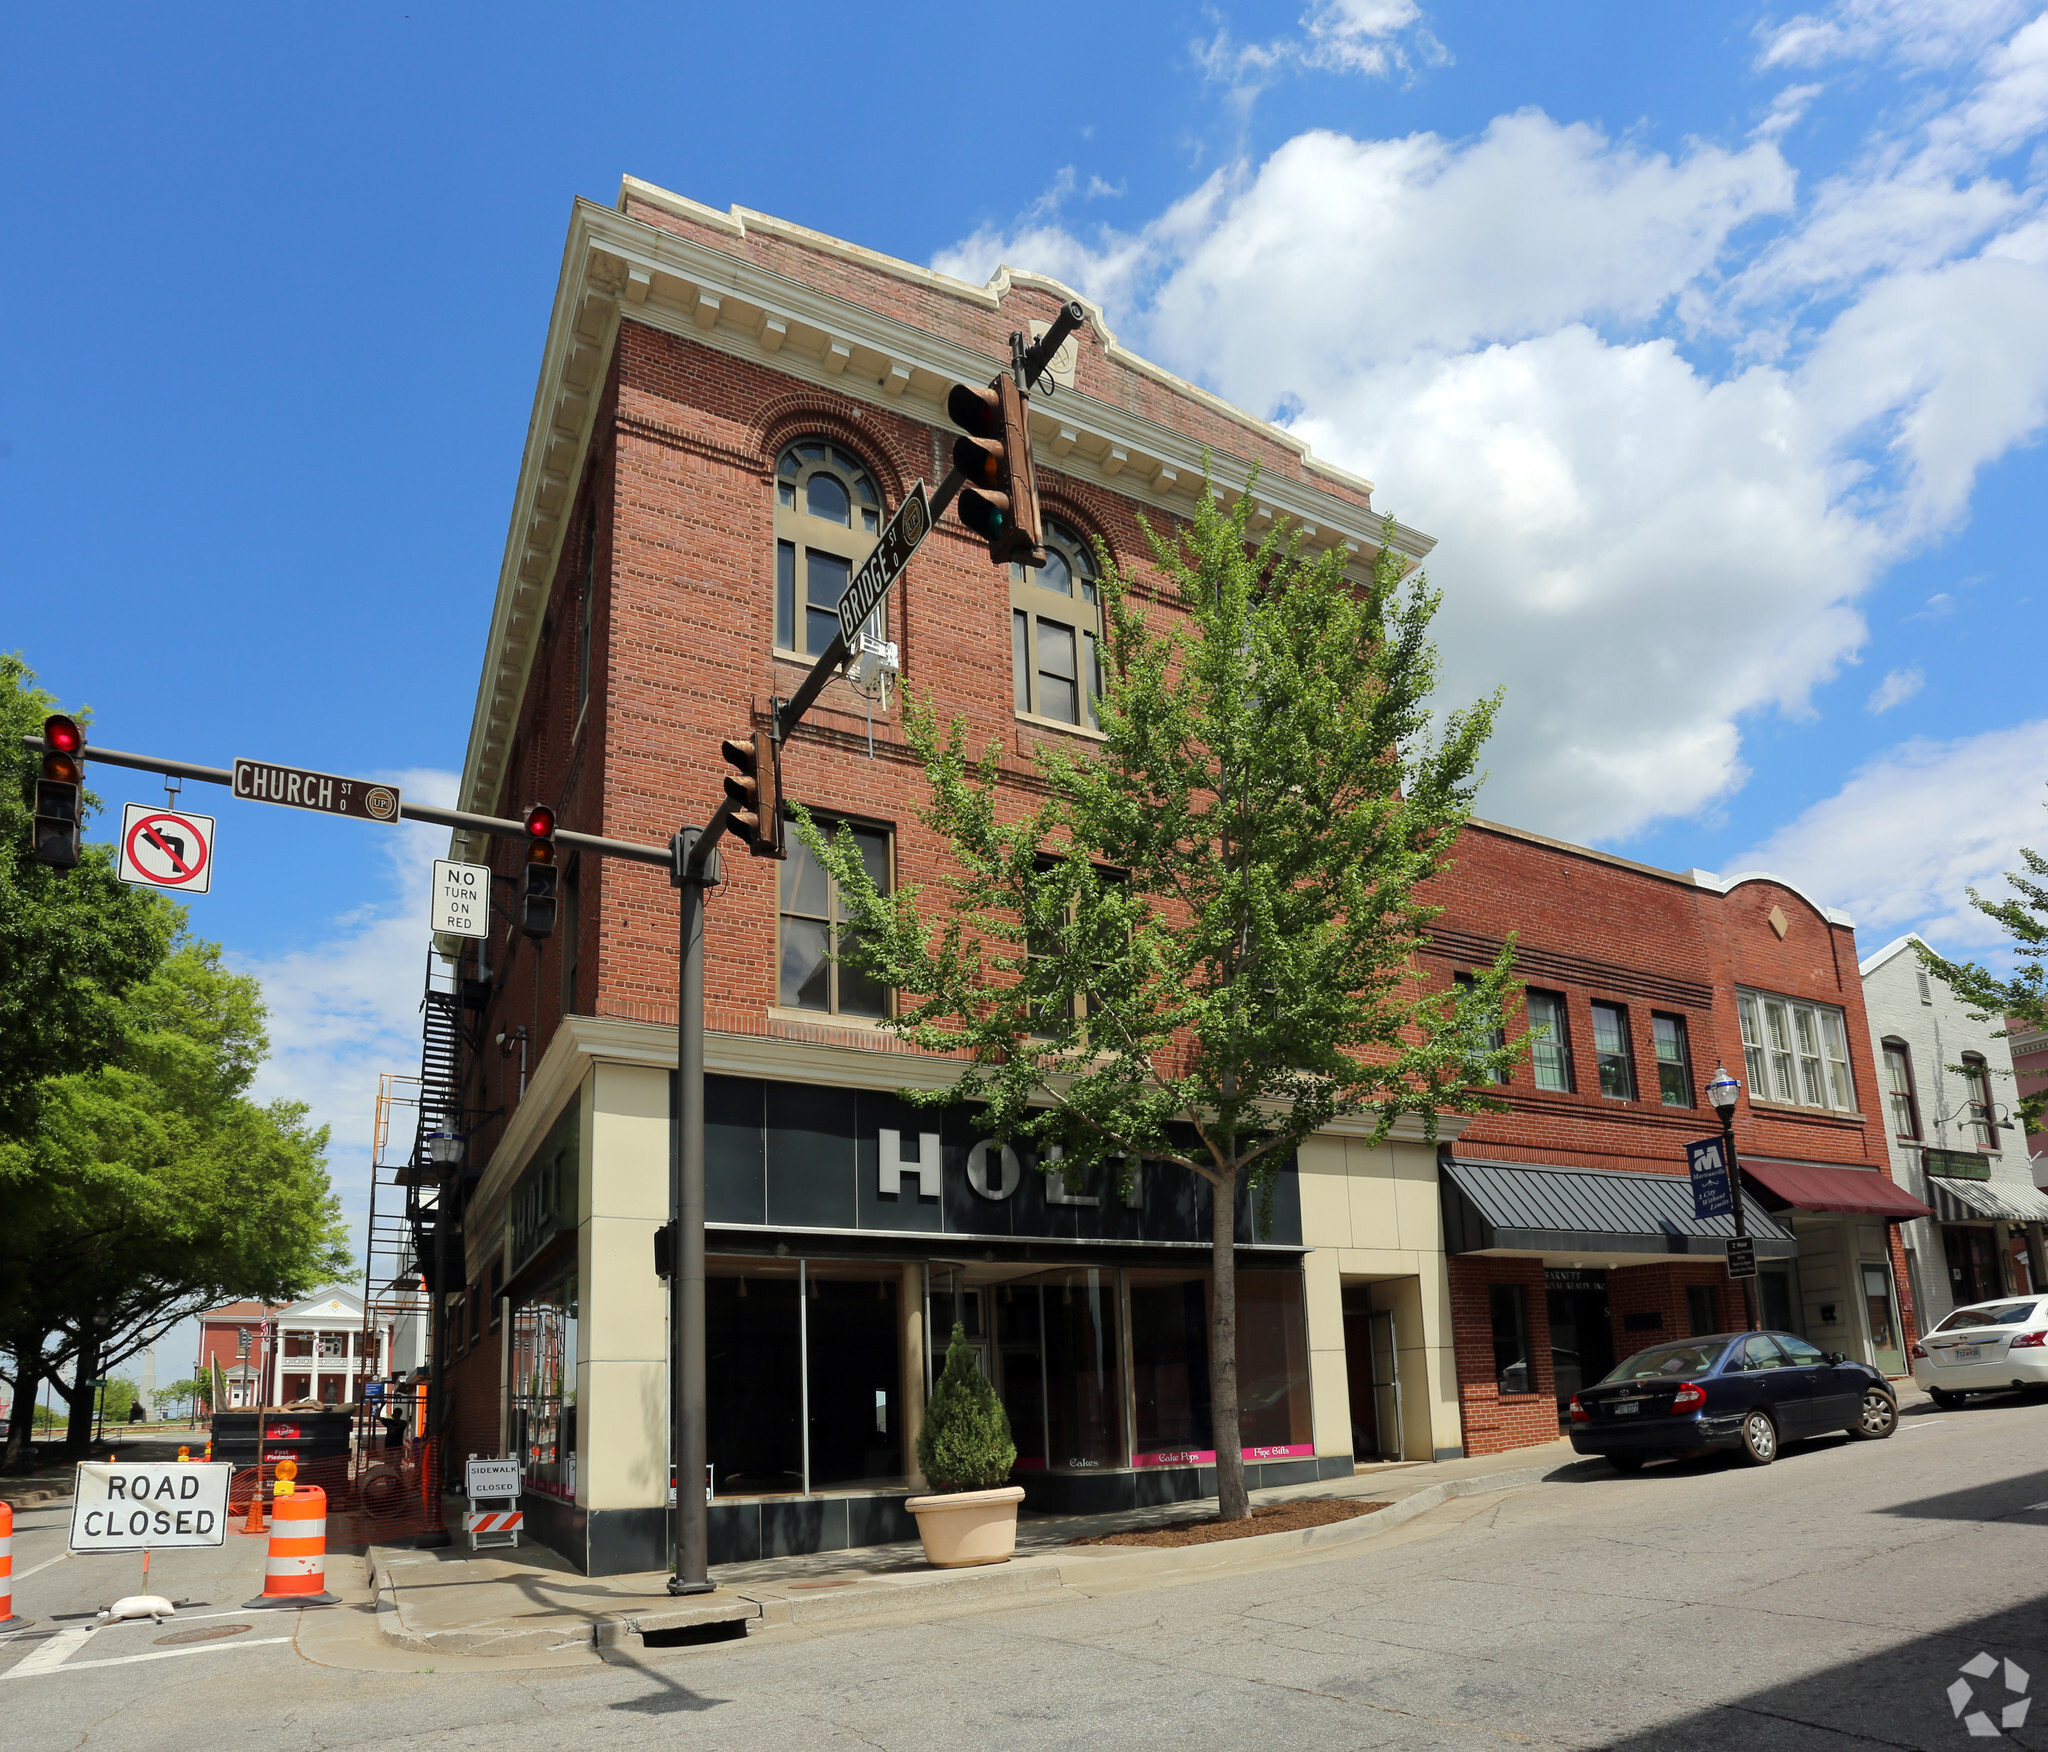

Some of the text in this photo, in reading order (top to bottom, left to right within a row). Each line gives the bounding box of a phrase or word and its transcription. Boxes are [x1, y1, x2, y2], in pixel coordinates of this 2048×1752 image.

[841, 526, 897, 636] BRIDGE ST
[237, 764, 333, 808] CHURCH
[341, 782, 352, 795] ST
[448, 869, 475, 885] NO
[444, 886, 477, 900] TURN
[451, 902, 469, 914] ON
[447, 916, 472, 929] RED
[1702, 1193, 1726, 1206] Without
[1703, 1190, 1716, 1198] City
[1710, 1200, 1729, 1211] Limits
[1272, 1446, 1290, 1456] Gifts
[1069, 1458, 1099, 1468] Cakes
[1158, 1452, 1199, 1463] Cake Pops
[471, 1466, 517, 1475] SIDEWALK
[107, 1476, 199, 1500] ROAD
[476, 1483, 513, 1491] CLOSED
[84, 1510, 215, 1536] CLOSED
